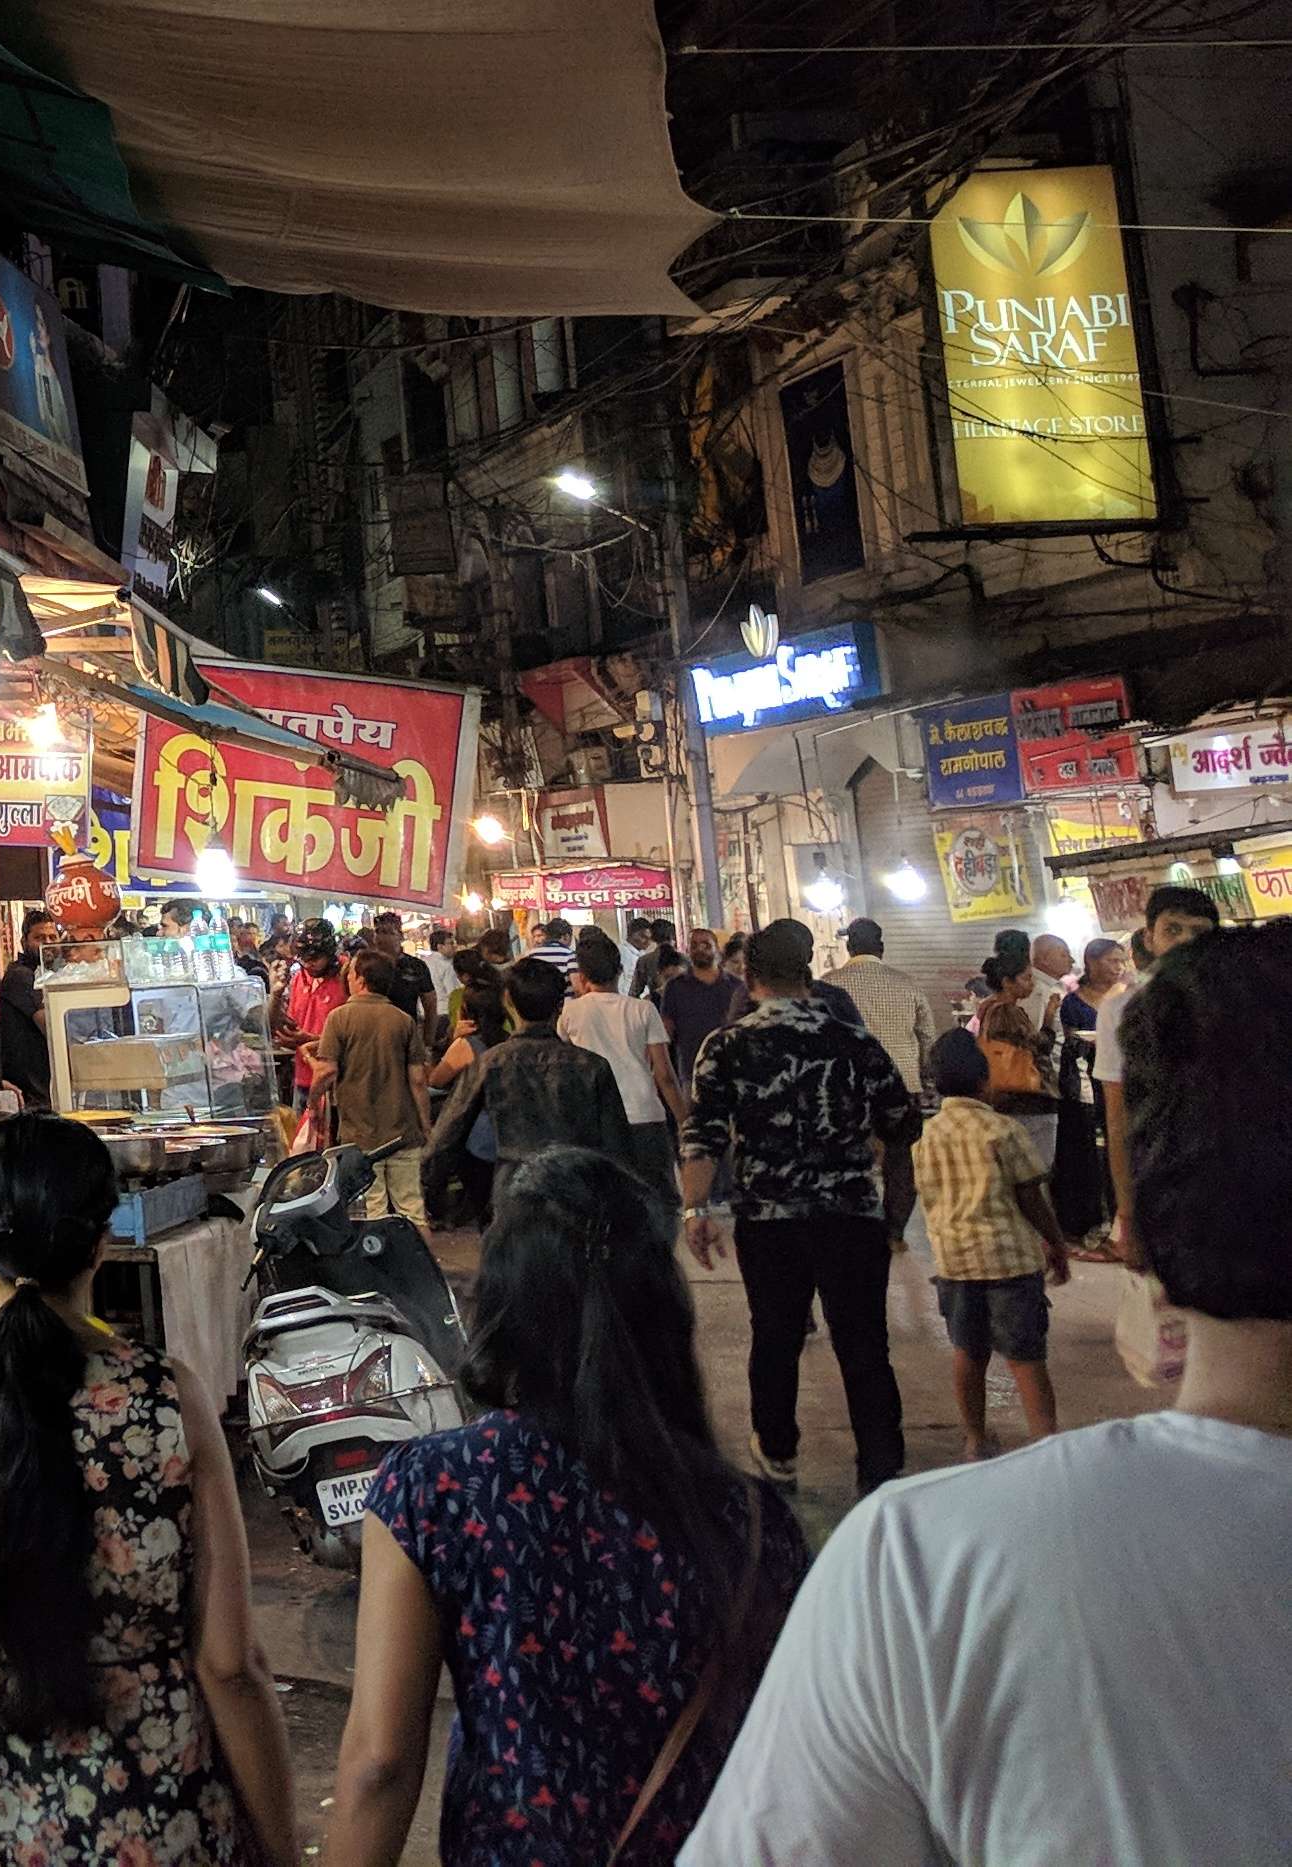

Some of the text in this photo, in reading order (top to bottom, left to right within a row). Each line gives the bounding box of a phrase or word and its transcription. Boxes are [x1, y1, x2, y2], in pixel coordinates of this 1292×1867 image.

[941, 288, 1131, 338] PUNJABI
[970, 322, 1107, 372] SARAF
[1073, 373, 1110, 386] SINCE
[952, 414, 1145, 440] HERITAGE STORE
[1191, 734, 1252, 774] आदर्श
[153, 732, 443, 894] शिकंजी
[48, 876, 97, 917] कुल्फी
